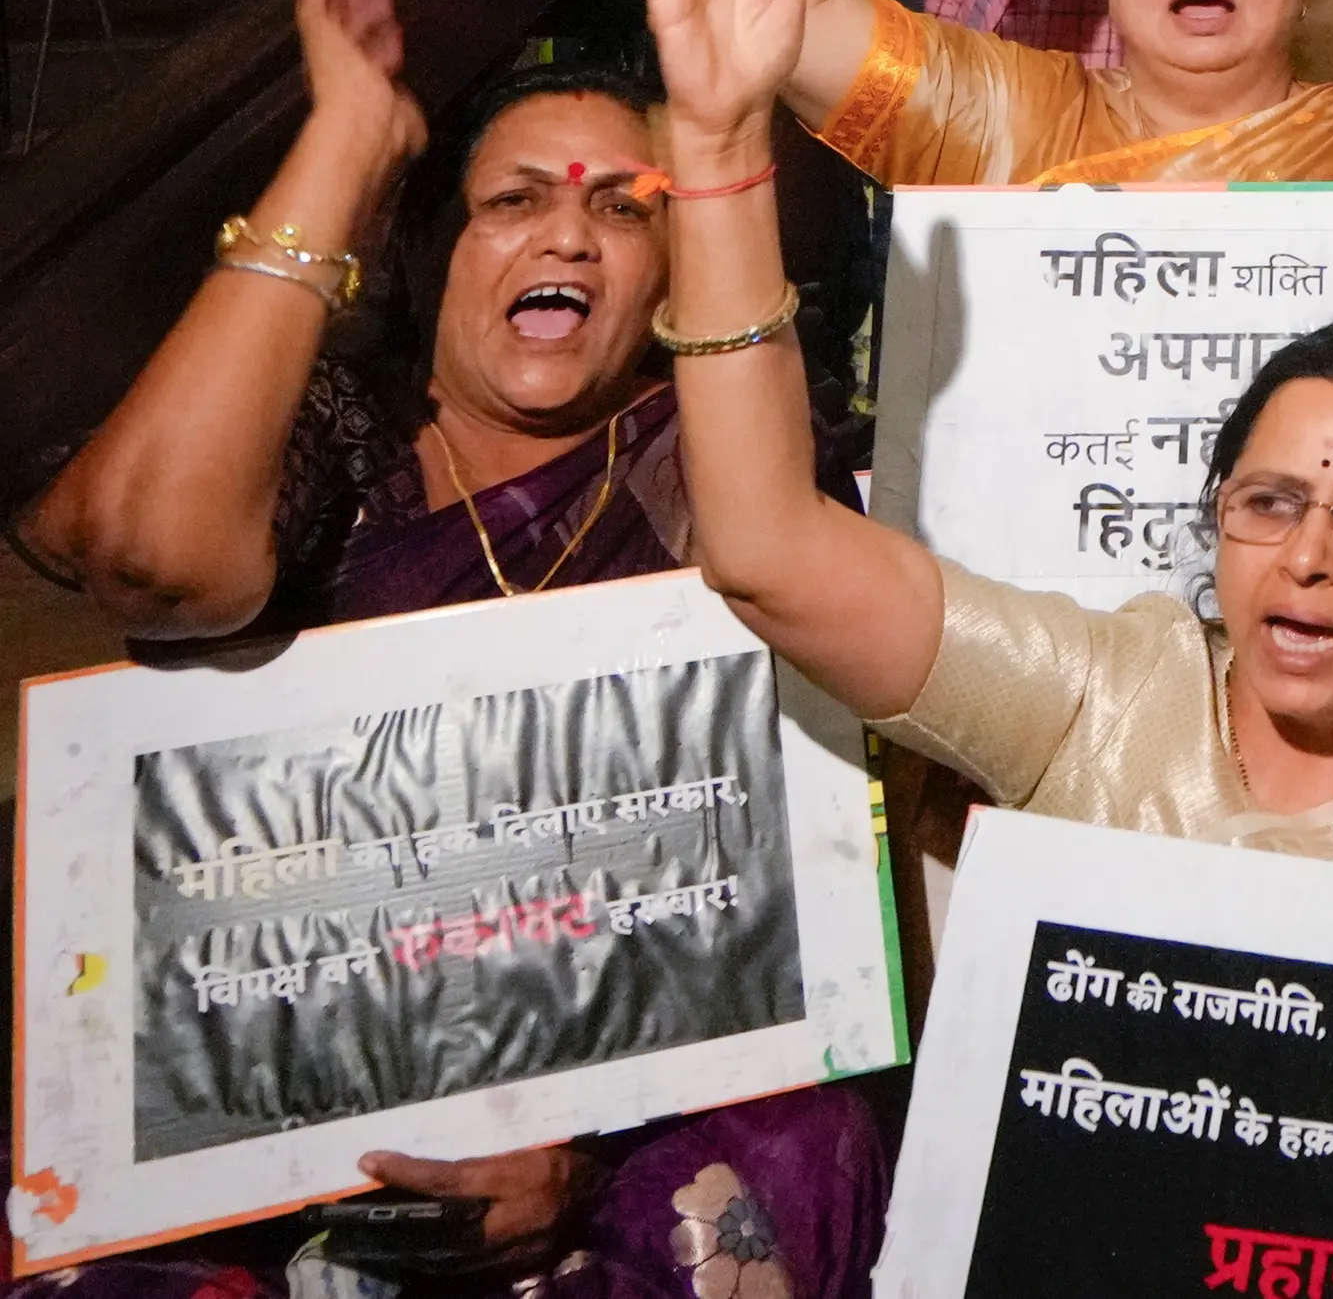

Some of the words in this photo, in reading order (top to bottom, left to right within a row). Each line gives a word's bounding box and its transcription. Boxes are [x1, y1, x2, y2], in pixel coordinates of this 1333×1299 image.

[1040, 232, 1226, 305] महिला
[1231, 253, 1328, 297] शक्ति
[1098, 332, 1304, 380] अपमा
[1045, 418, 1139, 470] कतई
[173, 837, 339, 904] महिला
[348, 841, 401, 873] का
[416, 821, 480, 868] हक
[492, 798, 607, 847] दिलाए
[614, 775, 749, 824] सरकार,
[193, 957, 309, 1012] विपक्ष
[319, 944, 381, 986] बने
[385, 891, 600, 972] रुकावट
[605, 897, 657, 936] हर
[657, 878, 740, 918] बार!
[1046, 949, 1123, 1008] ढोंग
[1127, 974, 1167, 1014] की
[1171, 977, 1325, 1041] राजनीति,
[1017, 1058, 1230, 1142] महिलाओं
[1234, 1107, 1274, 1148] के
